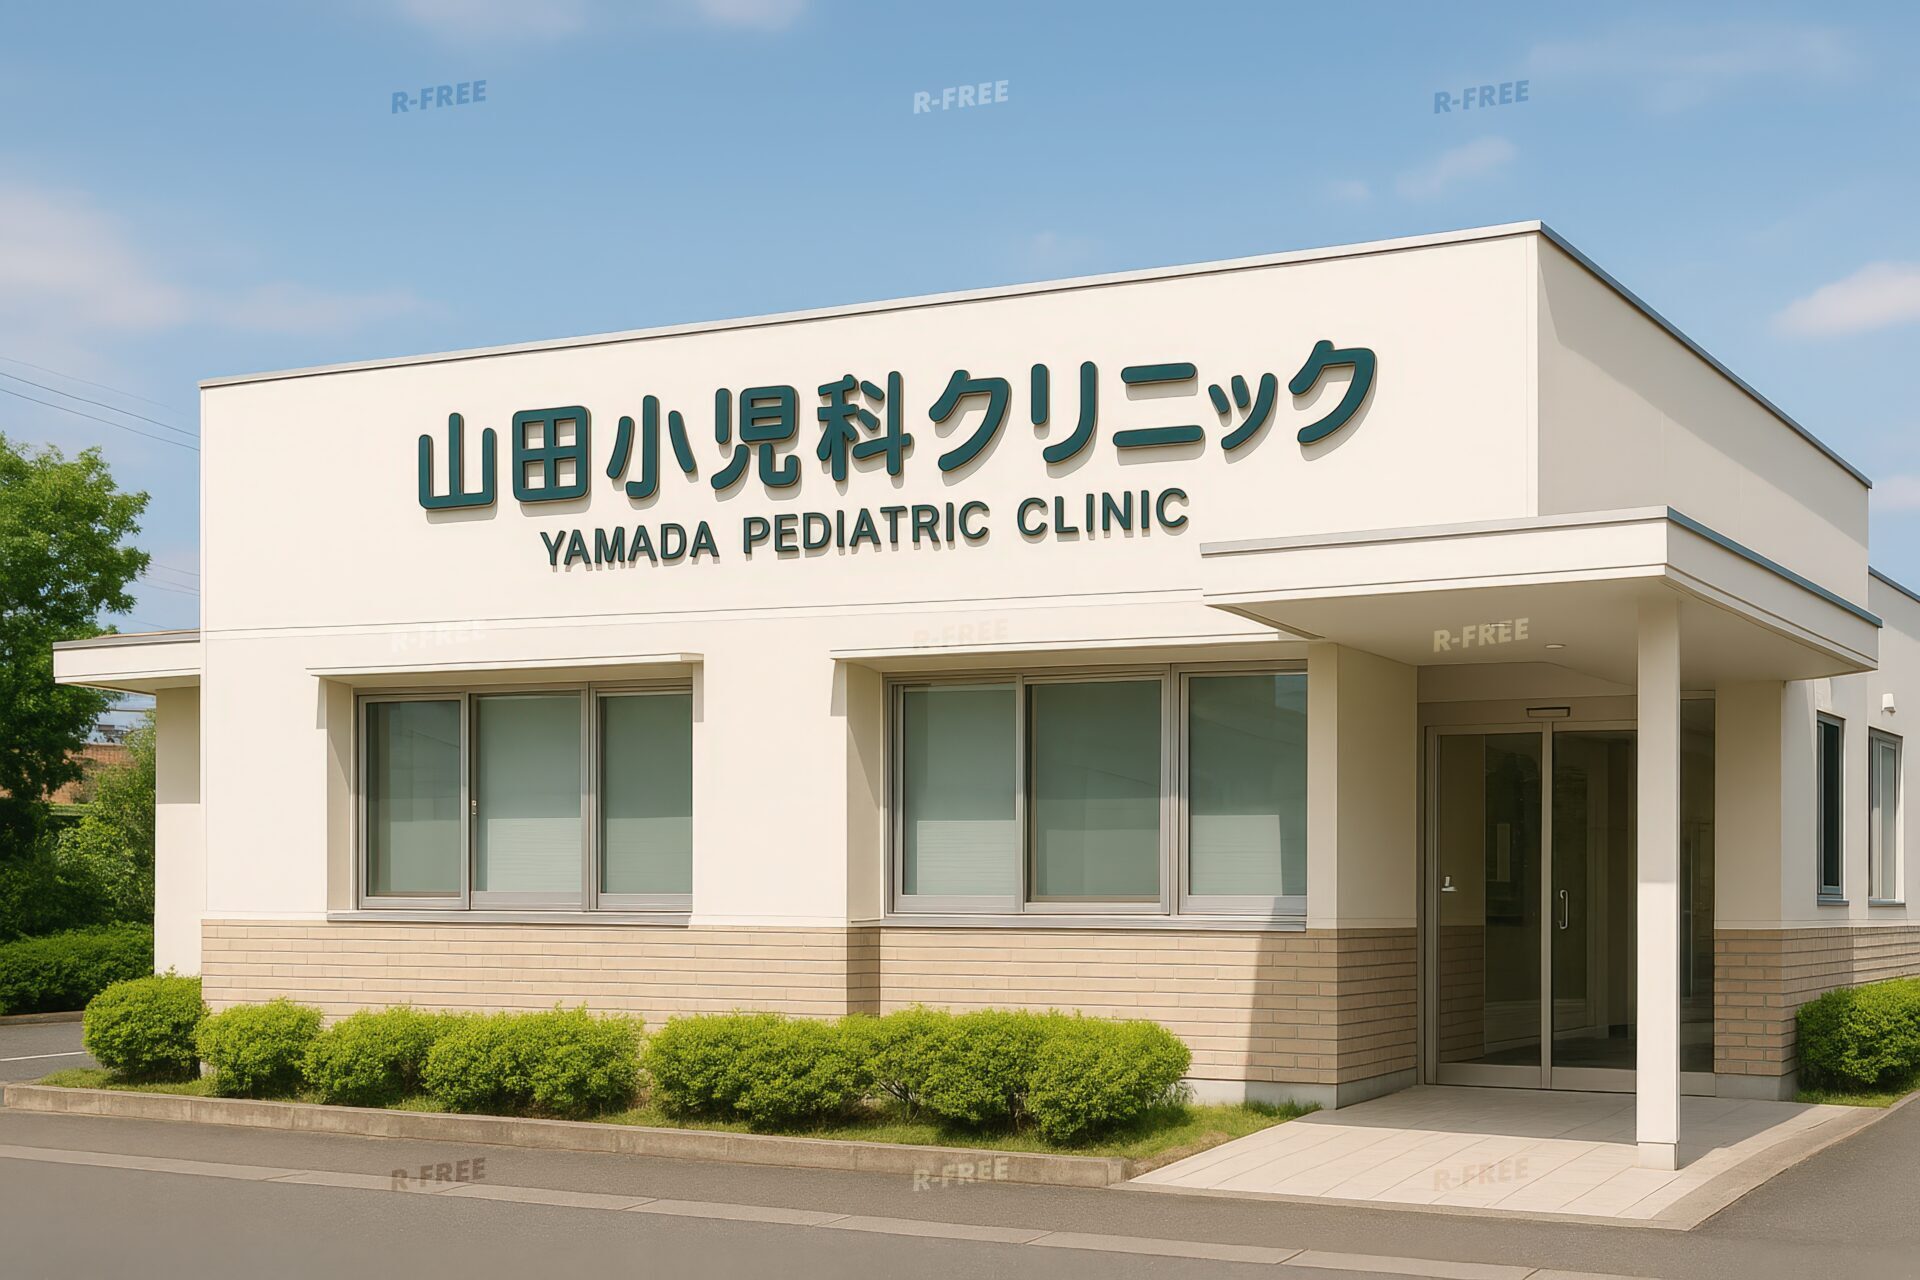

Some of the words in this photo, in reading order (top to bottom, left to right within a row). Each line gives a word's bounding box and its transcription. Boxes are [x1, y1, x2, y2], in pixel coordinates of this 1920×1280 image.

[418, 340, 1378, 511] 山田小児科クリニック
[540, 519, 720, 566] YAMADA
[743, 499, 991, 555] PEDIATRIC
[1016, 487, 1191, 537] CLINIC
